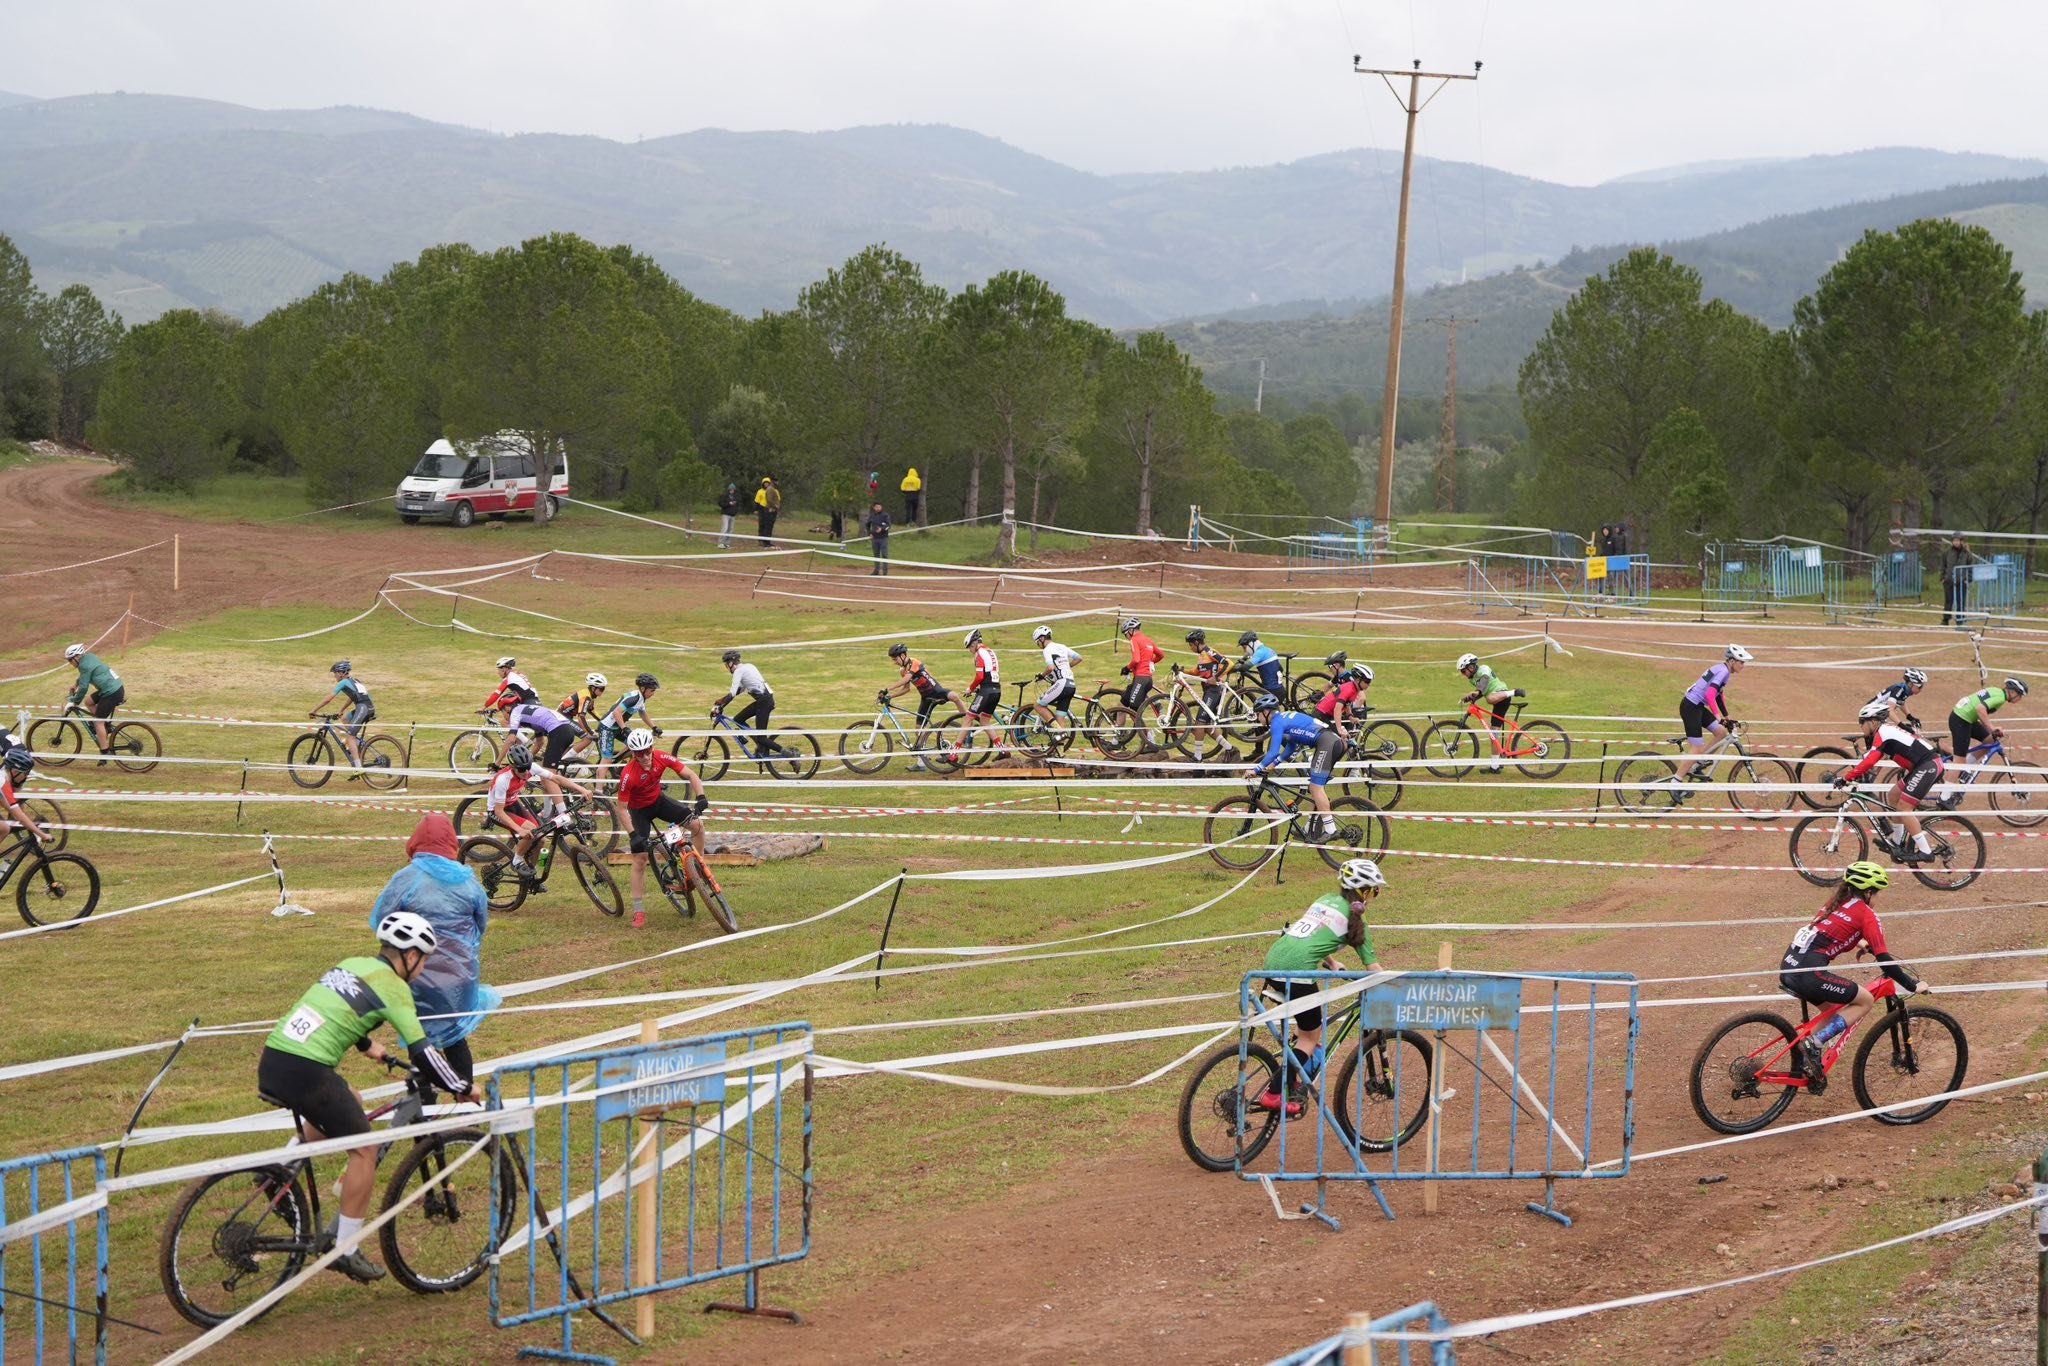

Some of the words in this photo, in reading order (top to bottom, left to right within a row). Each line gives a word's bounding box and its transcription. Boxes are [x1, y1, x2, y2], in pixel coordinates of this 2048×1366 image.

[1905, 769, 1927, 792] GÜRAL
[671, 832, 678, 840] 2
[1295, 921, 1312, 934] 70
[1796, 929, 1810, 942] 76
[1820, 982, 1846, 995] SİVAS
[290, 1016, 311, 1036] 48
